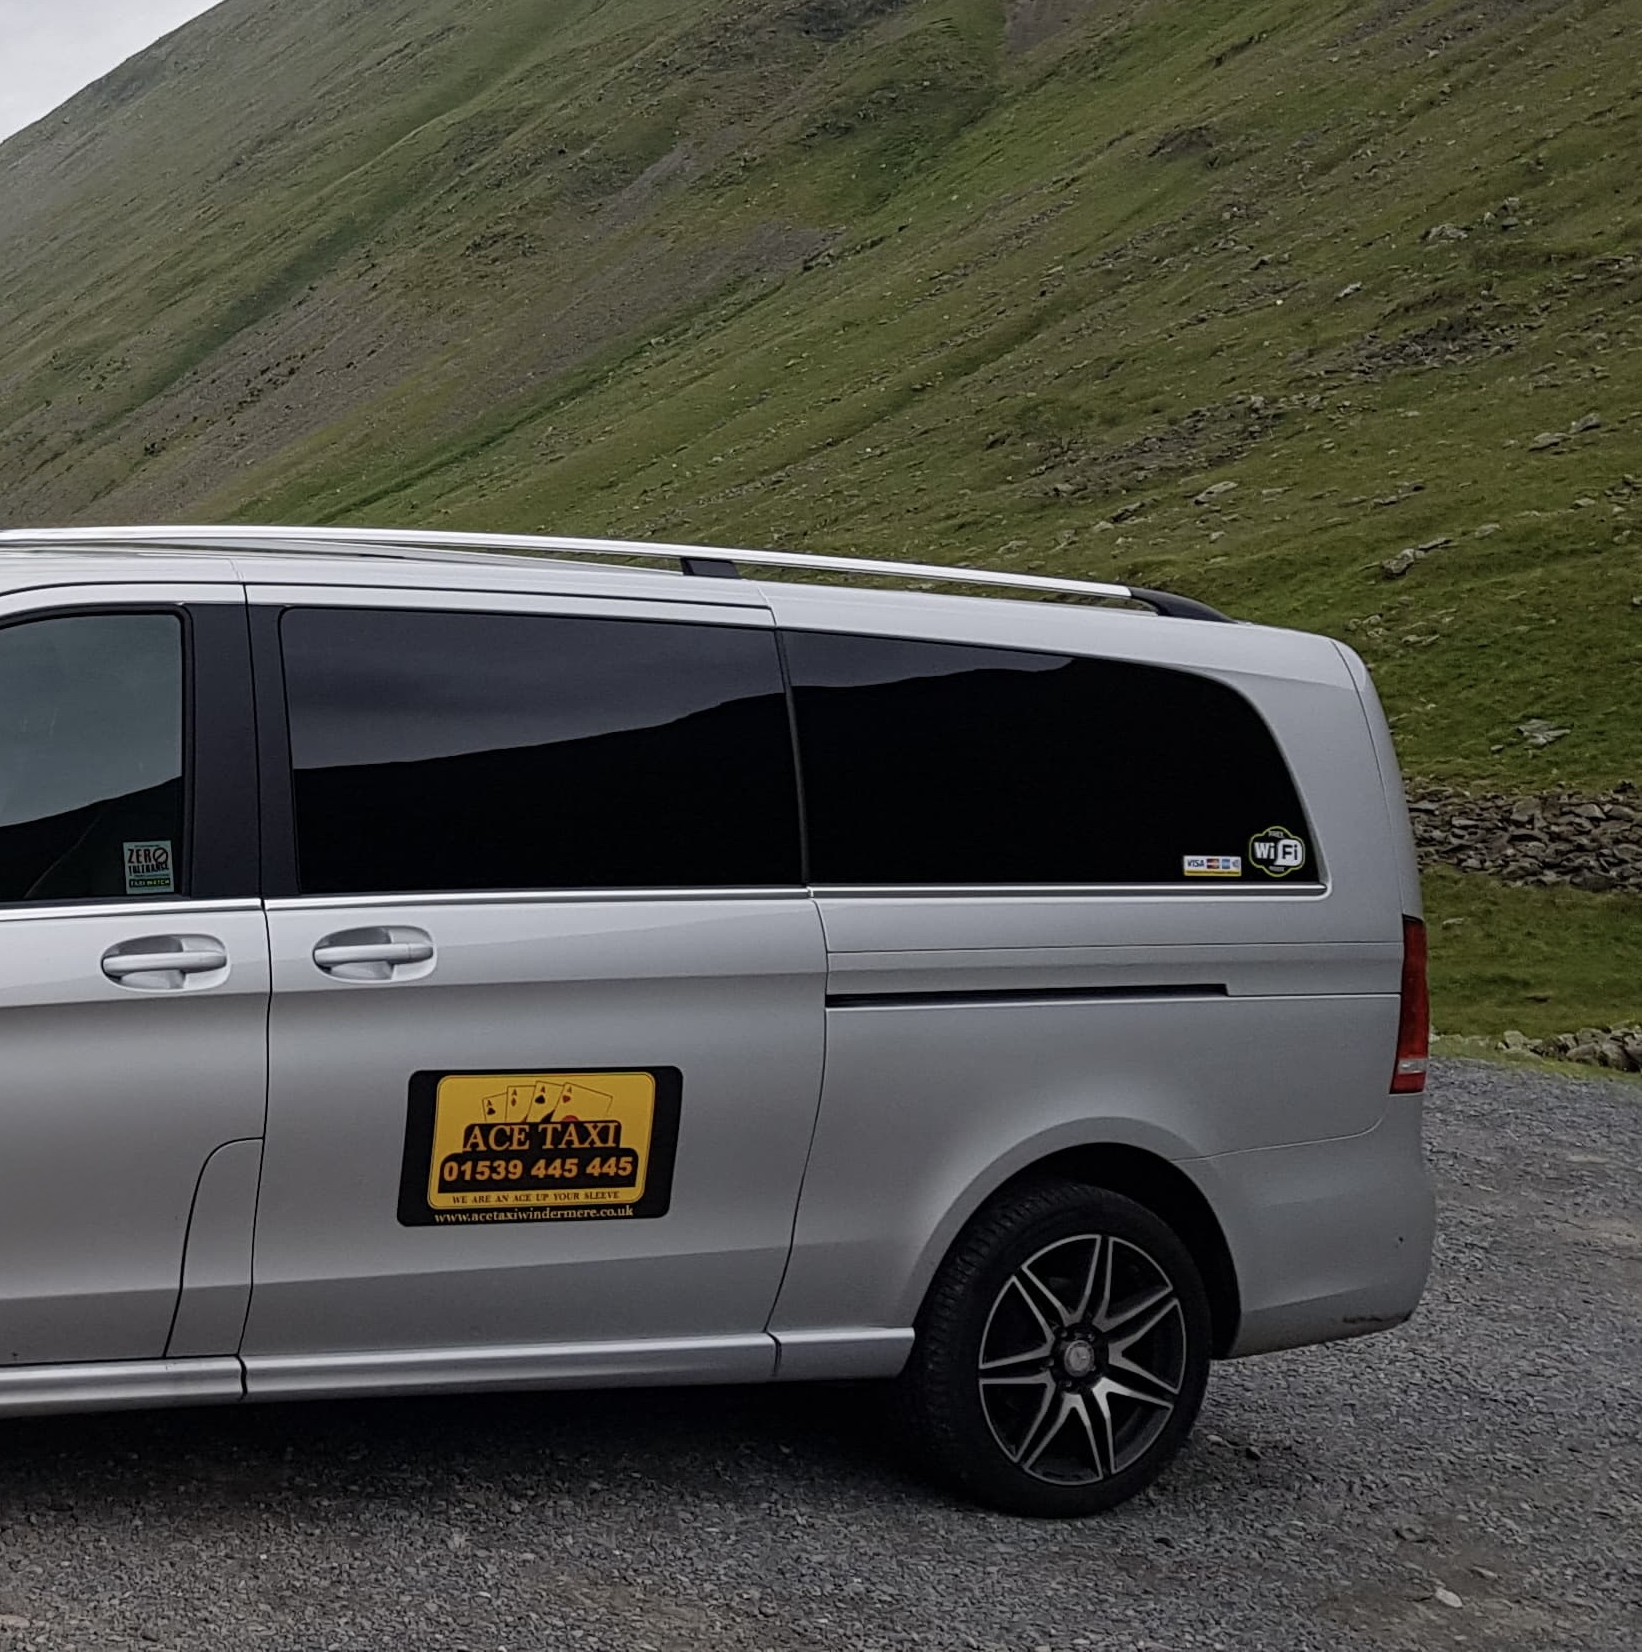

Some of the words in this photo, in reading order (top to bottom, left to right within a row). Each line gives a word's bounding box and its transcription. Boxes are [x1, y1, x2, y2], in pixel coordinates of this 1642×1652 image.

[1187, 859, 1205, 868] VISA
[465, 1124, 530, 1152] ACE
[538, 1122, 619, 1149] TAXI
[443, 1159, 523, 1182] 01539
[530, 1158, 579, 1179] 445
[586, 1156, 634, 1177] 445
[452, 1195, 468, 1204] WE
[472, 1194, 491, 1204] ARE
[494, 1194, 510, 1203] AN
[514, 1193, 532, 1202] ACE
[535, 1193, 550, 1202] UP
[553, 1192, 580, 1201] YOUR
[583, 1190, 620, 1200] SLEEVE
[434, 1204, 634, 1223] www.acetaxiwindermere.co.uk
